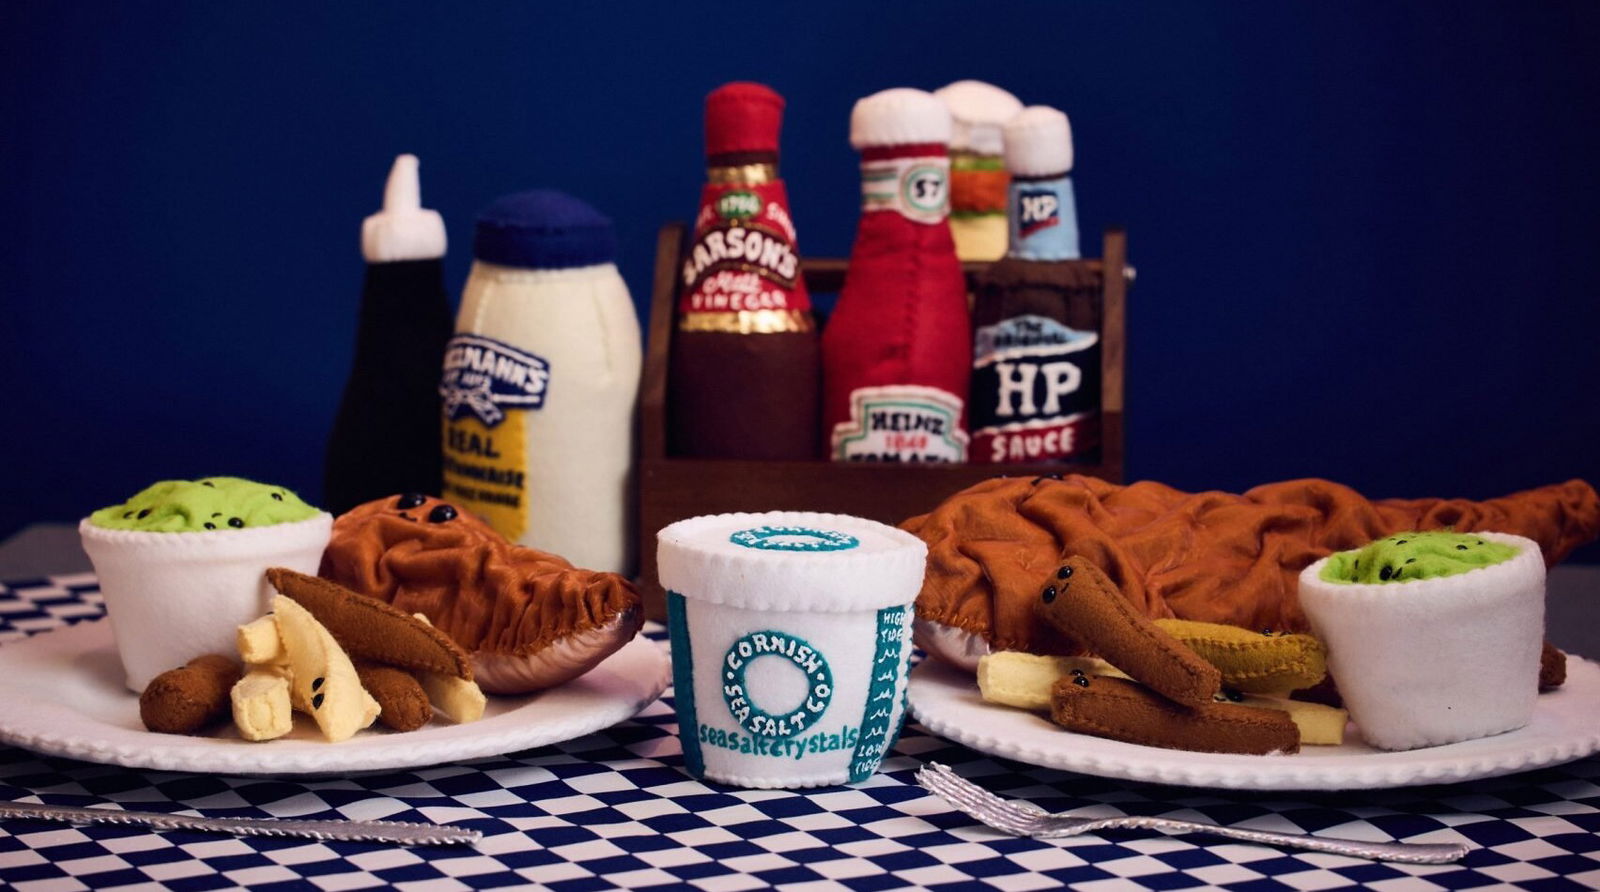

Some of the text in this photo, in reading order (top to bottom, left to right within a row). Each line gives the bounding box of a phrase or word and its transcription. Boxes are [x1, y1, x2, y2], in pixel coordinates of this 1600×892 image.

[915, 178, 942, 199] 57
[1021, 194, 1059, 223] HP
[691, 289, 787, 311] VINEGAR
[994, 361, 1083, 416] HP
[870, 411, 944, 436] HEINZ
[991, 426, 1075, 462] SAUCE
[727, 633, 823, 674] CORNISH
[724, 684, 750, 725] SEA
[749, 711, 806, 737] SALT
